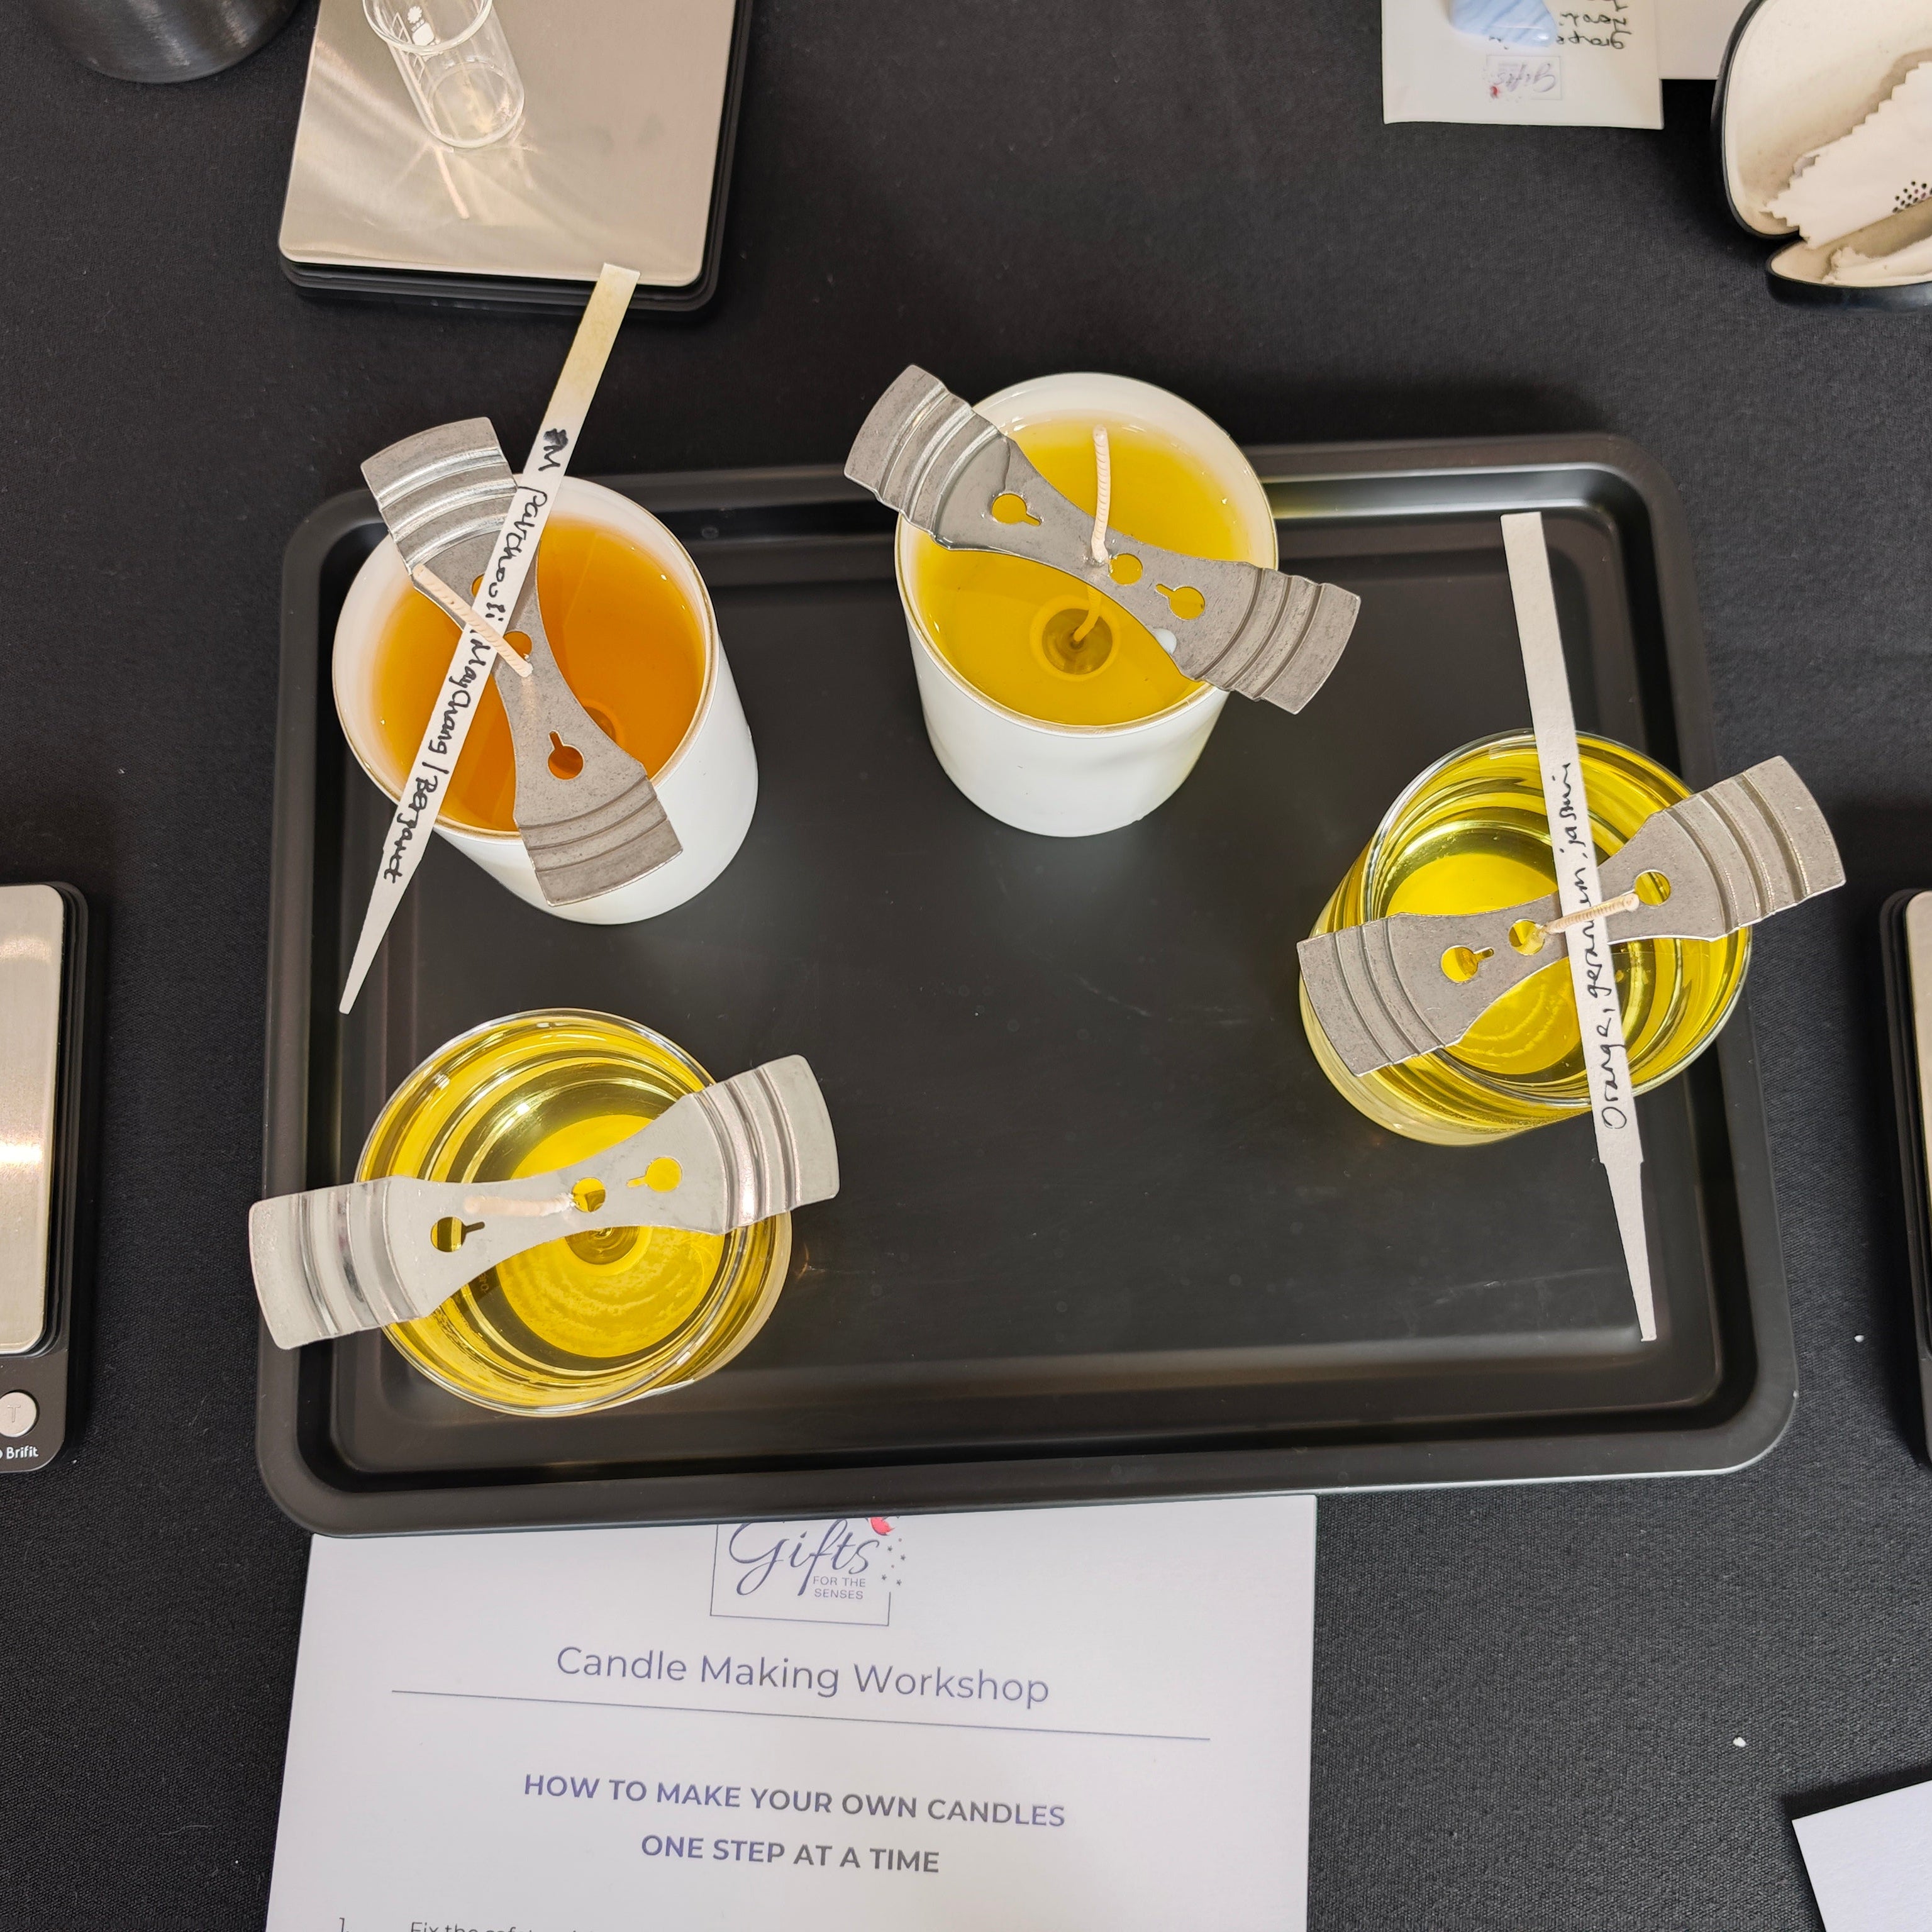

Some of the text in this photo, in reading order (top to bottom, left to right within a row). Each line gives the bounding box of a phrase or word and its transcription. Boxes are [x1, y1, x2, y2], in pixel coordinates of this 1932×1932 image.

[6, 1445, 39, 1459] Brifit
[729, 1518, 880, 1596] Gifts
[813, 1575, 866, 1587] FOR THE
[814, 1589, 863, 1600] SENSES
[557, 1646, 1049, 1709] Candle Making Workshop
[524, 1774, 1065, 1827] HOW TO MAKE YOUR OWN CANDLES
[641, 1834, 940, 1874] ONE STEP AT A TIME
